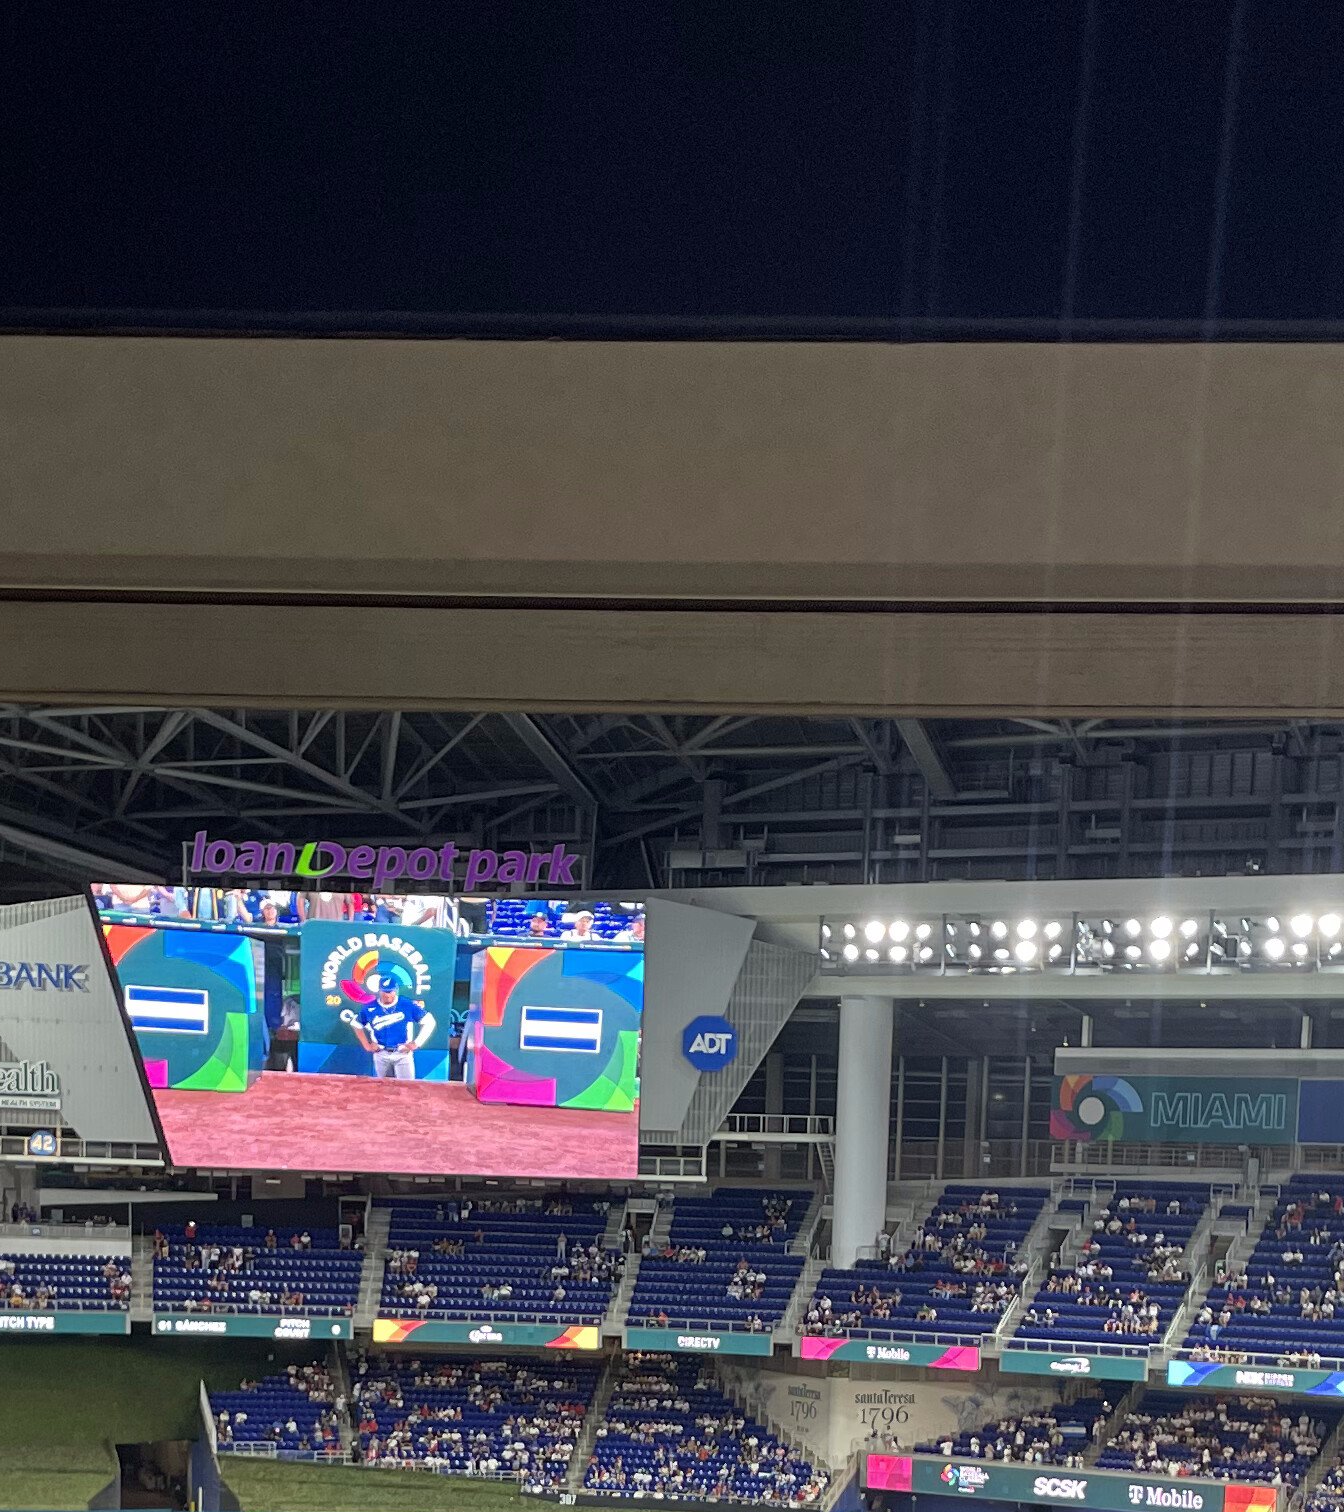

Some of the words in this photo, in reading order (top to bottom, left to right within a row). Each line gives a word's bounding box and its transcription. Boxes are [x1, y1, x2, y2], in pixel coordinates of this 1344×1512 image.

[464, 843, 580, 892] park
[322, 937, 363, 989] WORLD
[364, 933, 431, 995] BASEBALL
[689, 1032, 733, 1055] ADT
[1150, 1092, 1286, 1130] MIAMI
[31, 1134, 53, 1151] 42
[27, 1316, 55, 1330] TYPE
[677, 1336, 720, 1349] DIRECTV
[790, 1401, 817, 1421] 1796
[861, 1405, 909, 1430] 1796
[1033, 1476, 1087, 1500] SCSK
[1146, 1486, 1203, 1510] Mobile
